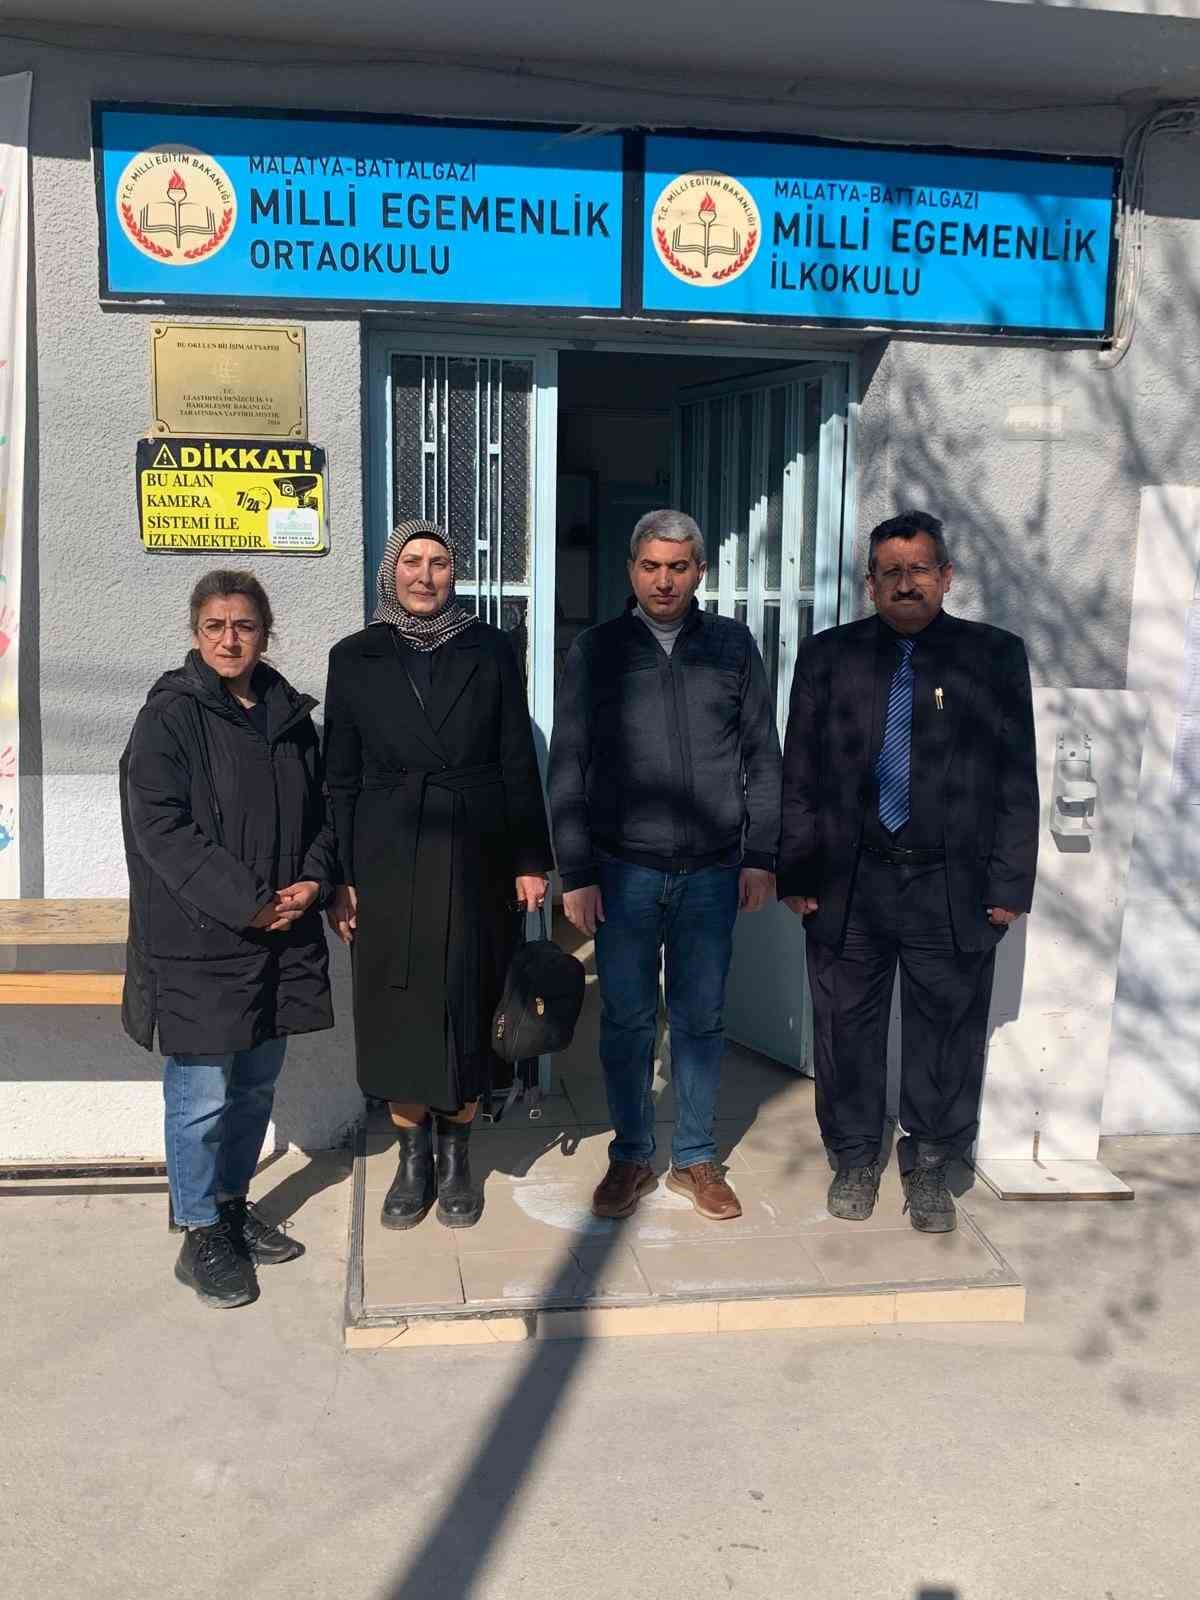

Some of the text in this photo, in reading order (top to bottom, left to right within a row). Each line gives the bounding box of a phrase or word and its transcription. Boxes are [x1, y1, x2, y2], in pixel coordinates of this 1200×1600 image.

[250, 179, 610, 238] MİLLİ EGEMENLİK
[773, 203, 1097, 264] MİLLİ EGEMENLİK
[250, 239, 450, 275] ORTAOKULU
[771, 252, 921, 296] İLKOKULU
[180, 443, 312, 470] DİKKAT!
[147, 473, 214, 488] BU ALAN
[147, 494, 212, 508] KAMERA
[236, 491, 261, 514] 7/24
[147, 513, 240, 530] SİSTEMİ İLE
[148, 531, 266, 548] İZLENMEKTEDİR.
